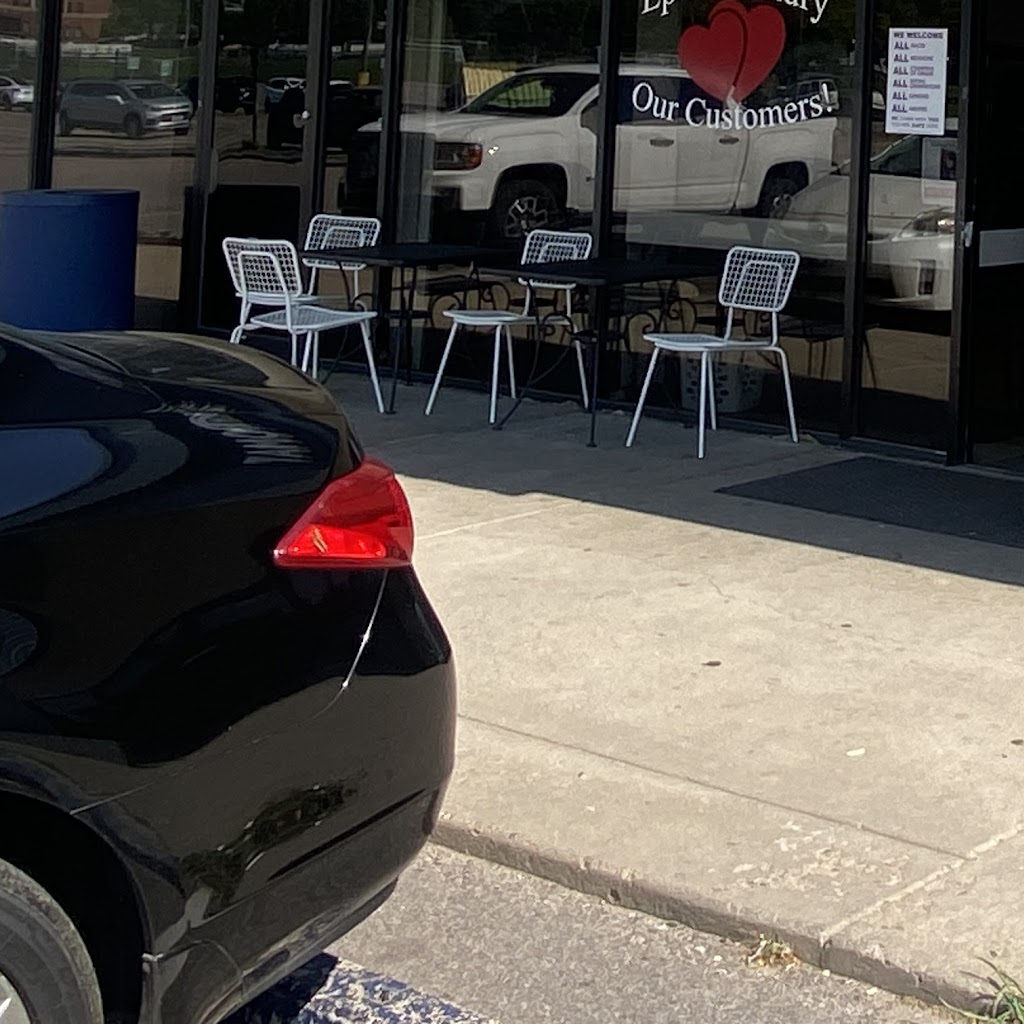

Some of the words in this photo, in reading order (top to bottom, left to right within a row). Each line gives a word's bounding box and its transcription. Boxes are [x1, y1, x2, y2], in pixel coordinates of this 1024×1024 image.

[894, 41, 910, 50] ALL
[894, 54, 909, 62] ALL
[893, 66, 908, 75] ALL
[893, 79, 908, 88] ALL
[892, 91, 908, 101] ALL
[632, 82, 679, 122] Our
[685, 83, 834, 130] Customers!
[892, 104, 908, 113] ALL
